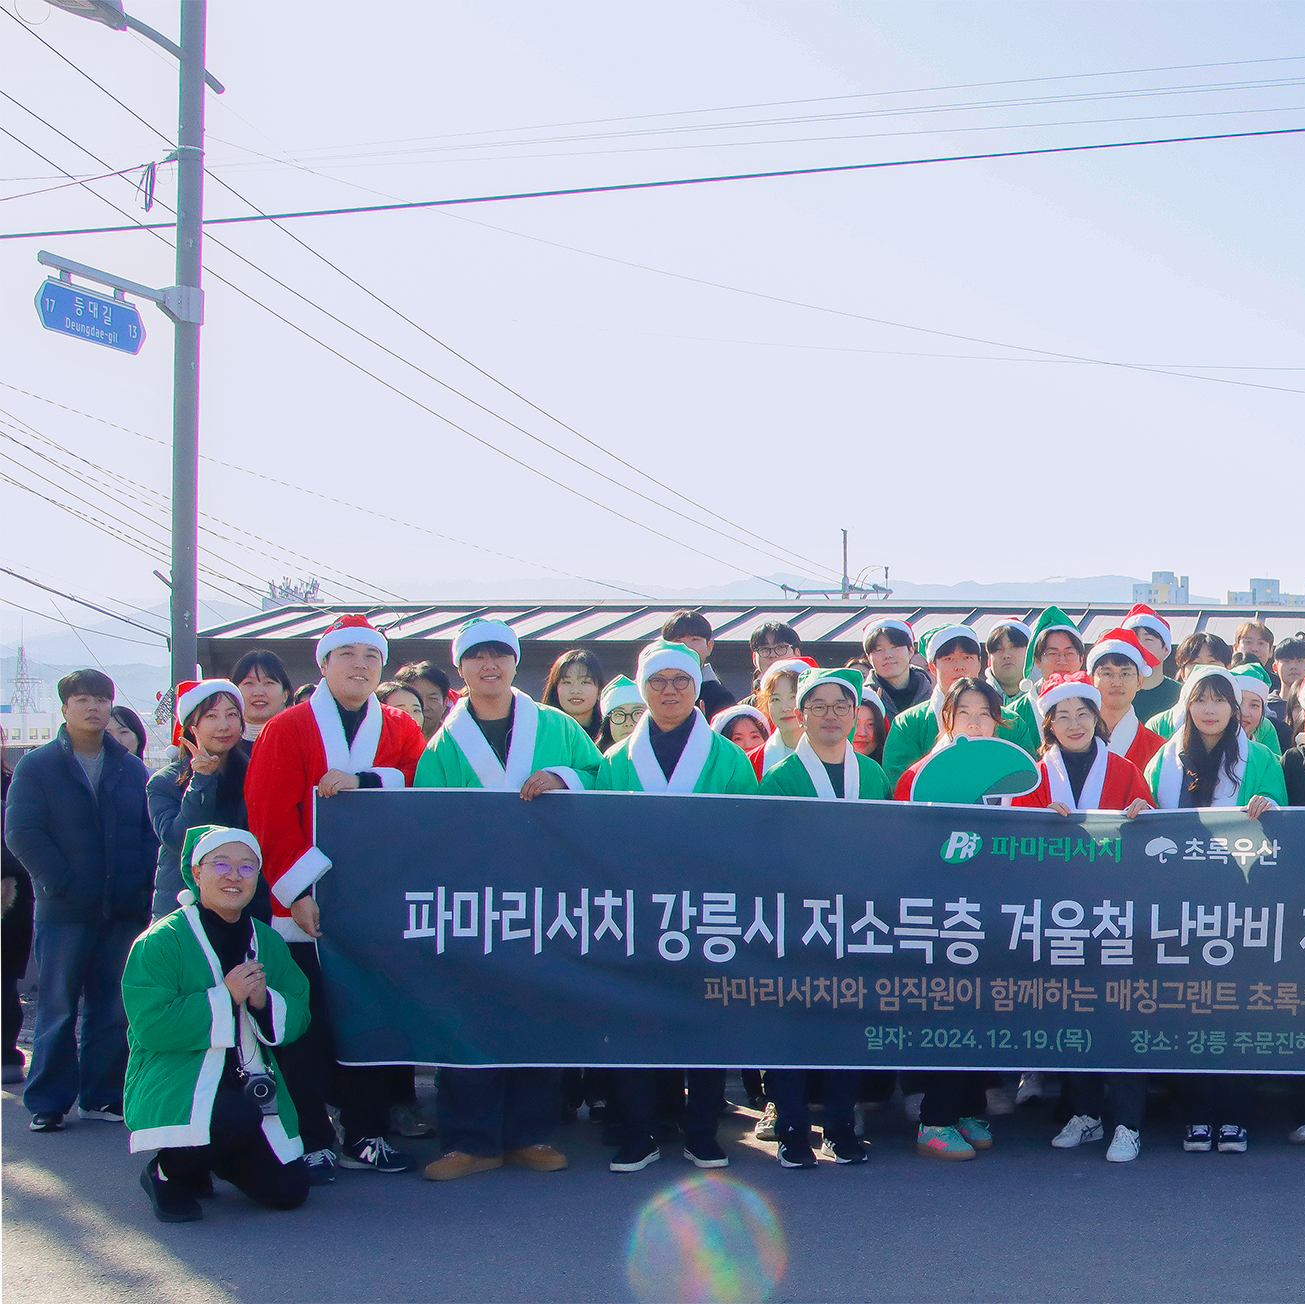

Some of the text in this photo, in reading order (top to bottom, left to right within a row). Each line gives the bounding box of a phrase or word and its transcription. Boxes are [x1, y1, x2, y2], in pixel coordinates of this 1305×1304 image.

[45, 298, 56, 313] 17
[73, 296, 113, 327] 등대길
[65, 316, 119, 344] Deungdae-gil
[128, 324, 138, 339] 13
[991, 836, 1122, 863] 파마리서치
[1182, 837, 1281, 866] 초록우산
[402, 887, 636, 957] 파마리서치
[652, 890, 787, 963] 강릉시
[801, 894, 985, 966] 저소득층
[1001, 898, 1134, 967] 겨울철
[1149, 901, 1286, 967] 난방비
[704, 976, 868, 1009] 파마리서치와
[875, 977, 981, 1012] 임직원이
[990, 978, 1098, 1013] 함께하는
[1106, 980, 1239, 1015] 매칭그랜트
[864, 1026, 913, 1050] 일자:
[1130, 1030, 1179, 1054] 장소:
[1187, 1030, 1228, 1055] 강릉
